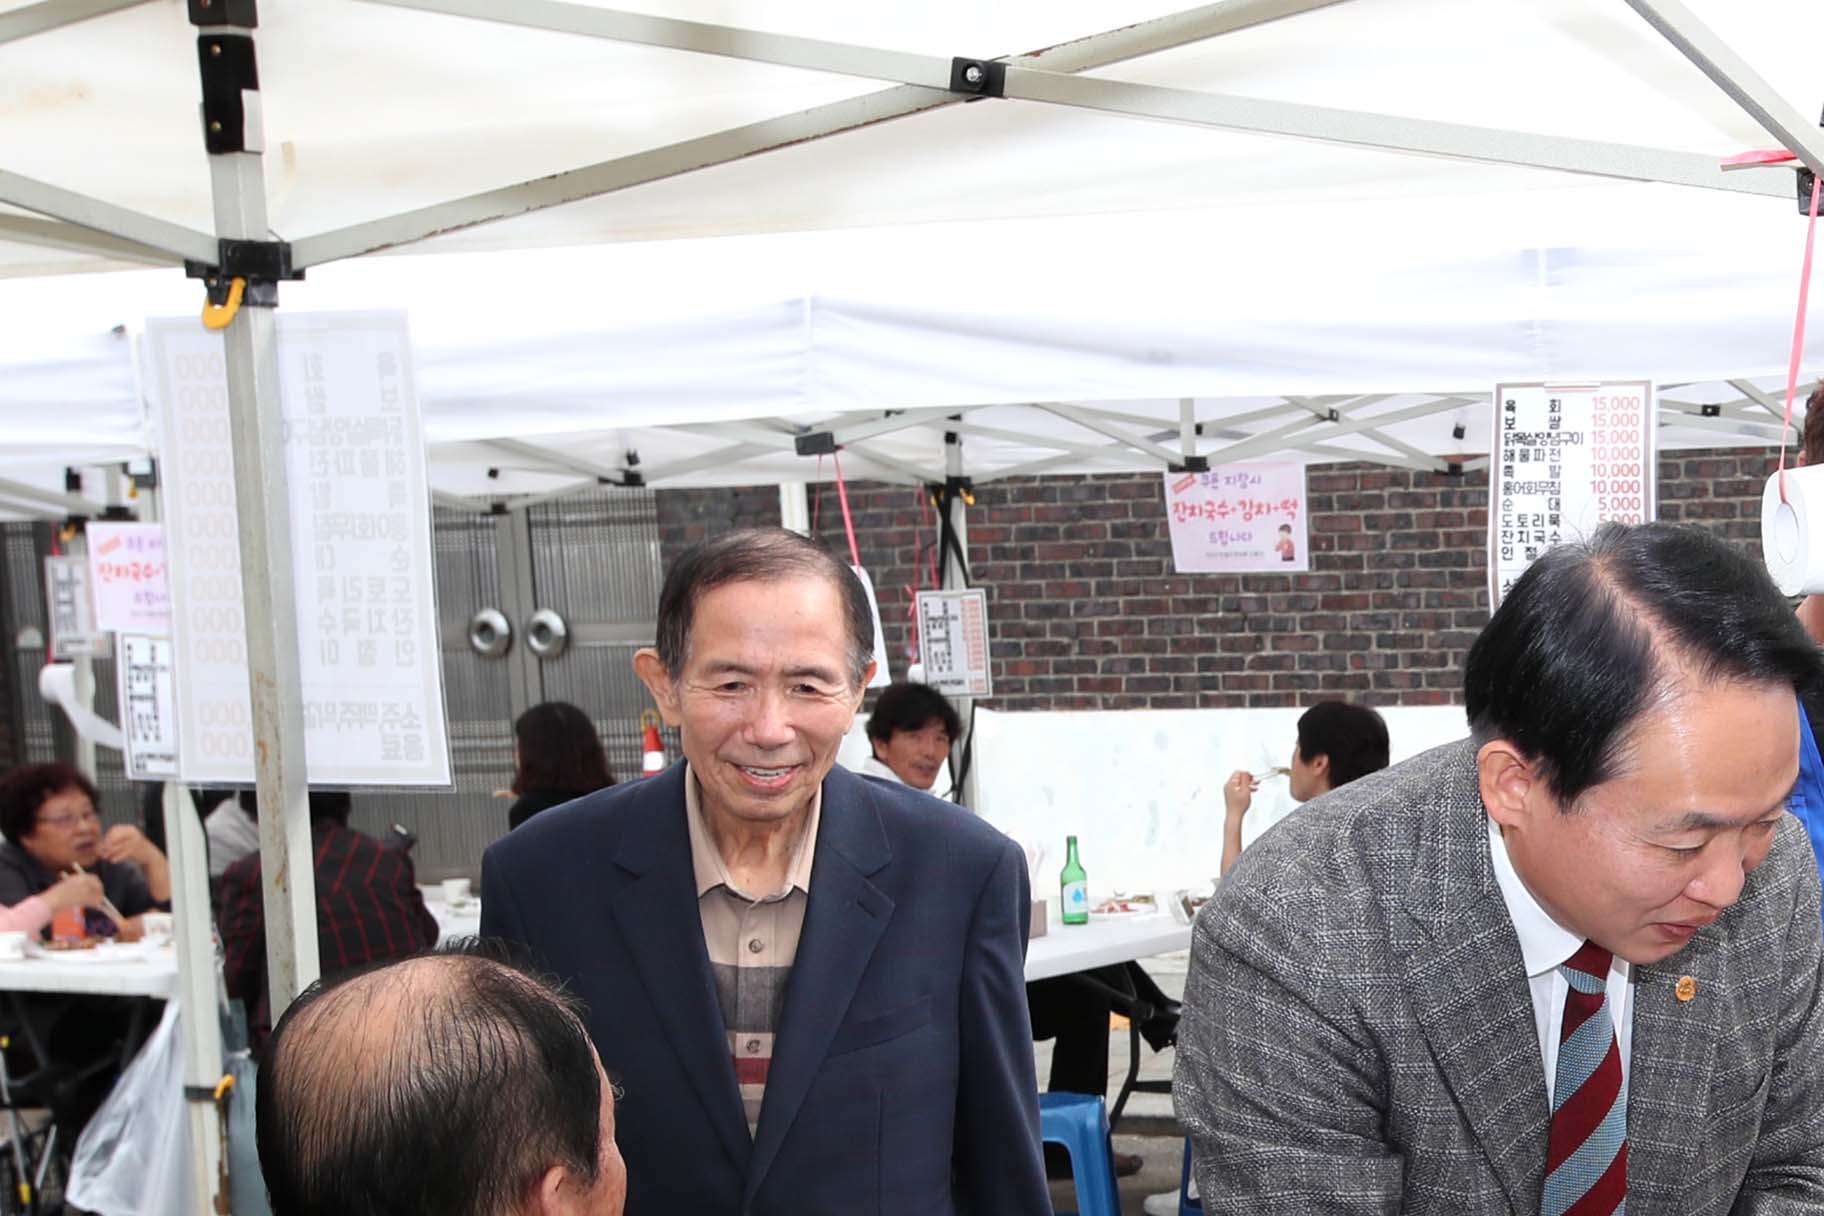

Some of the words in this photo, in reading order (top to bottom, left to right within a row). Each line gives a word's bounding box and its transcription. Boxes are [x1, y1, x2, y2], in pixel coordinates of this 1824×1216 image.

[1592, 396, 1640, 412] 15,000
[1591, 413, 1640, 429] 15,000
[1590, 430, 1639, 445] 15,000
[1590, 446, 1640, 462] 10,000
[1590, 463, 1640, 479] 10,000
[1589, 480, 1640, 495] 10,000
[1598, 496, 1641, 512] 5,000
